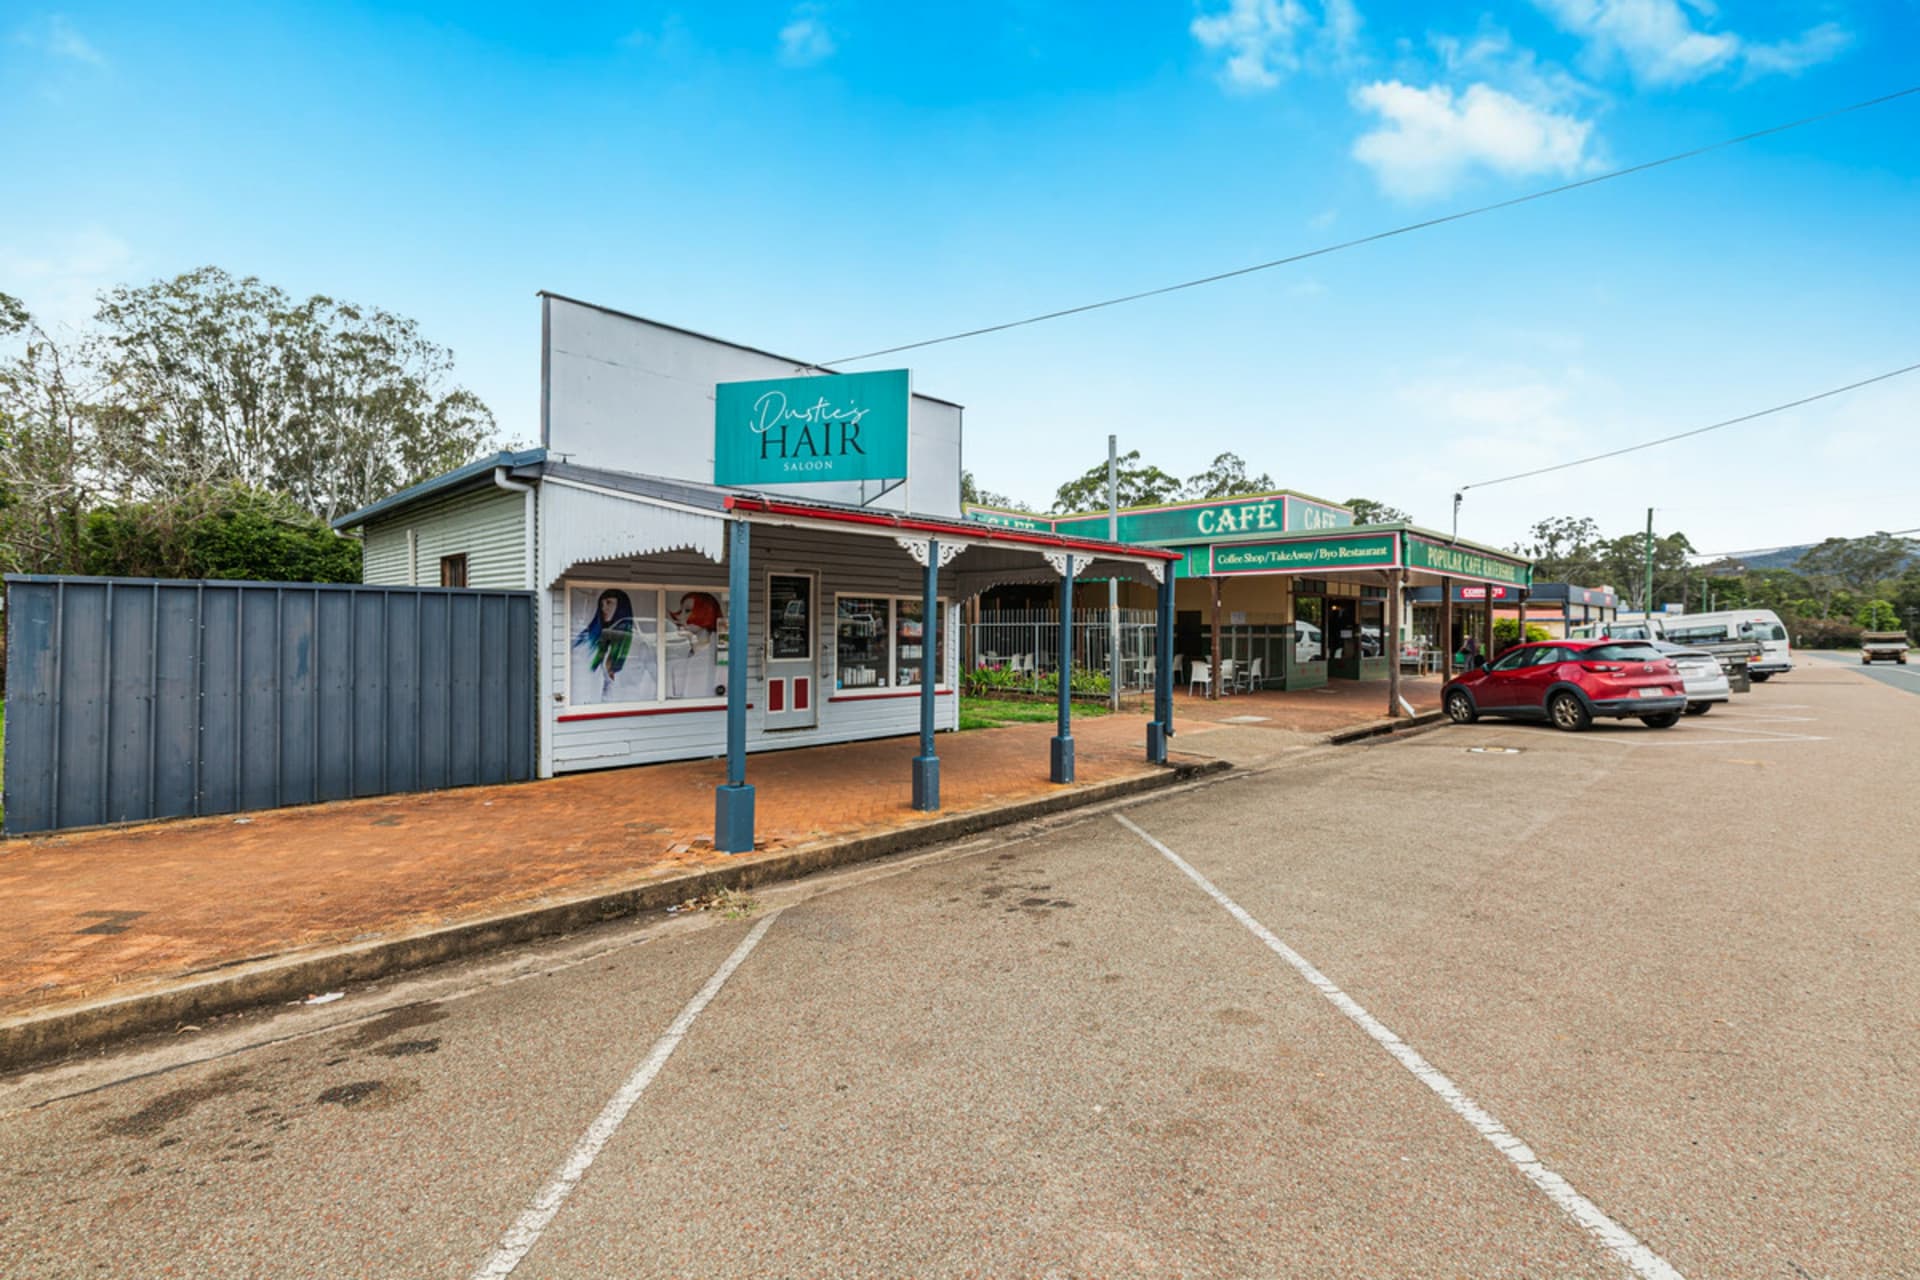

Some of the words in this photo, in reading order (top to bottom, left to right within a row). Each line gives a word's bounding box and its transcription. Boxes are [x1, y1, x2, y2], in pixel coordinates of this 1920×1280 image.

[750, 390, 870, 433] Dustie's
[761, 421, 867, 459] HAIR
[783, 460, 833, 471] SALOON
[1198, 497, 1277, 534] CAFÉ
[1218, 554, 1242, 565] Coffee
[1338, 546, 1387, 558] Restaurant
[1428, 546, 1462, 573] POPULAR
